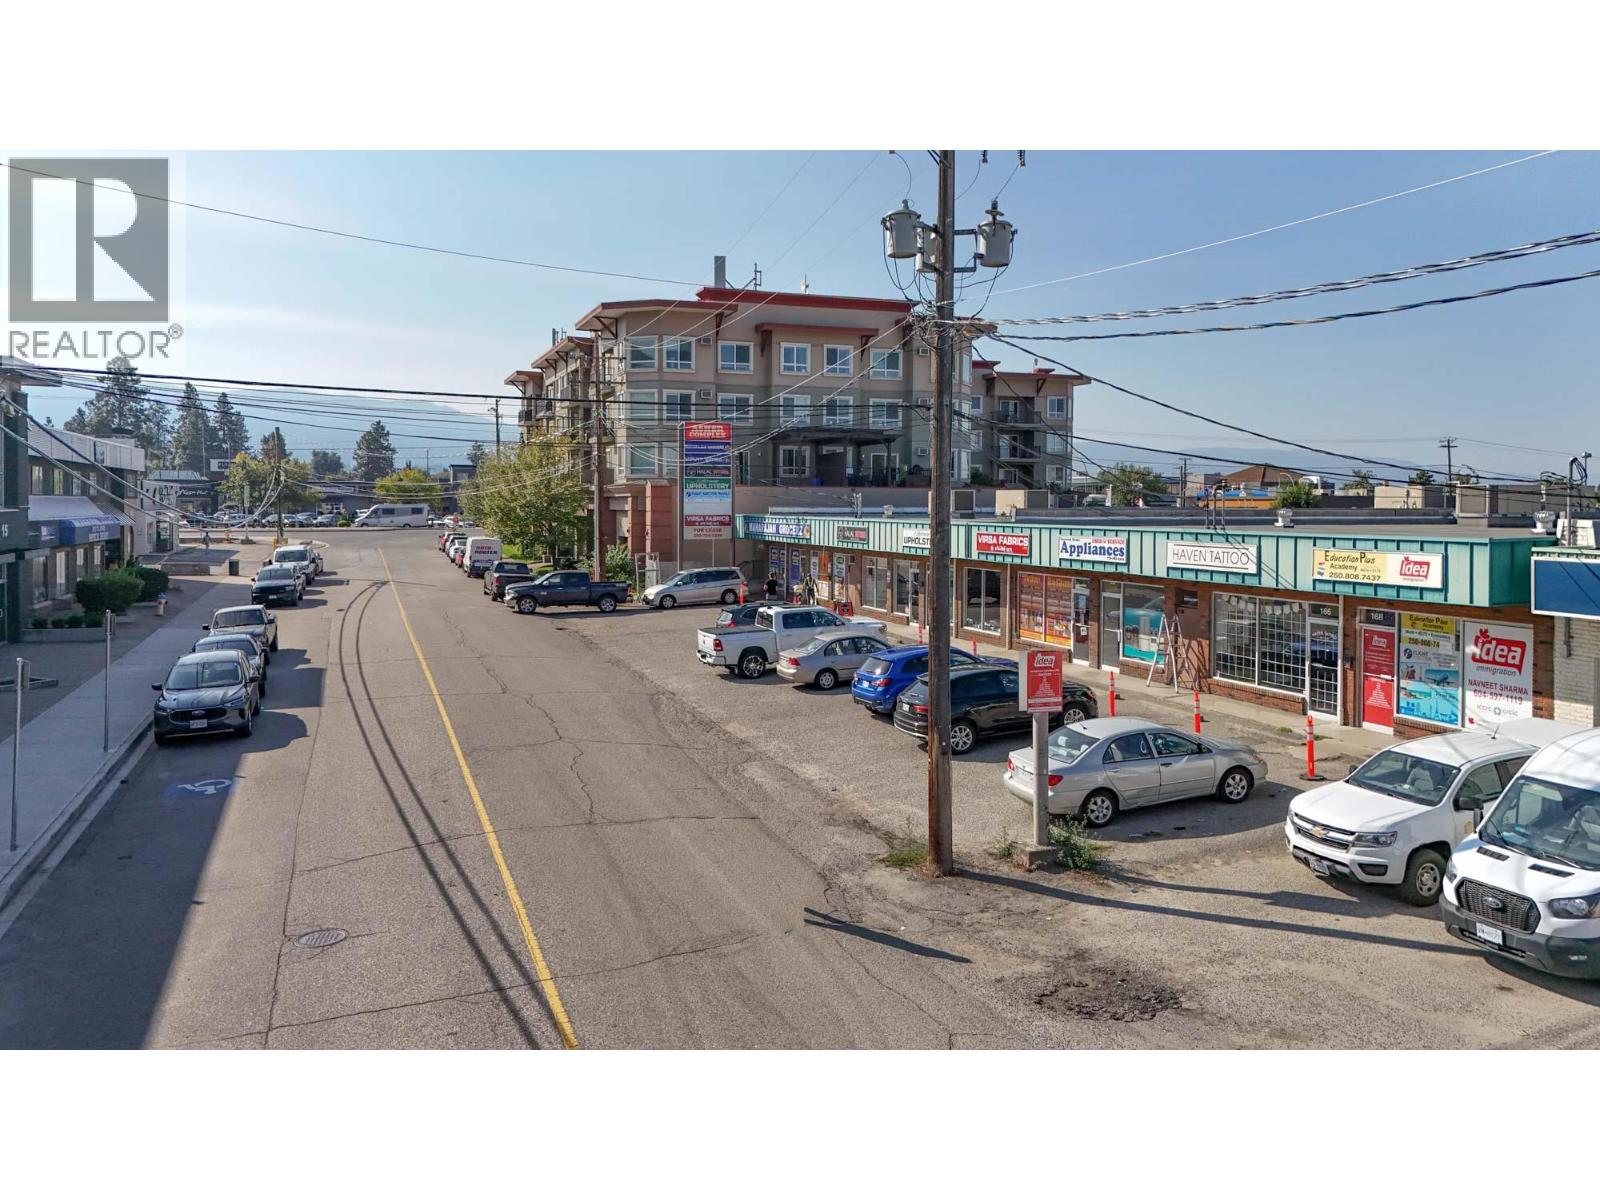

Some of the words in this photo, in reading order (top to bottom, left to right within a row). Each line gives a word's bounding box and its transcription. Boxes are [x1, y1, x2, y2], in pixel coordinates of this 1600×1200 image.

[903, 536, 930, 546] UPHOLST
[977, 533, 998, 545] VIRSA
[999, 536, 1029, 547] FABRICS
[1060, 540, 1125, 557] Appliances
[1172, 548, 1207, 562] HAVEN
[1209, 550, 1250, 566] TATTOO
[1324, 550, 1360, 564] Education
[1360, 552, 1376, 565] Plus
[1329, 562, 1358, 572] Academy
[1401, 560, 1429, 577] idea
[1320, 607, 1332, 616] 166
[1474, 636, 1523, 666] idea
[1035, 654, 1054, 666] idea
[1475, 665, 1517, 677] immigration
[1467, 679, 1498, 690] NAVNEET
[1499, 683, 1529, 695] SHARMA
